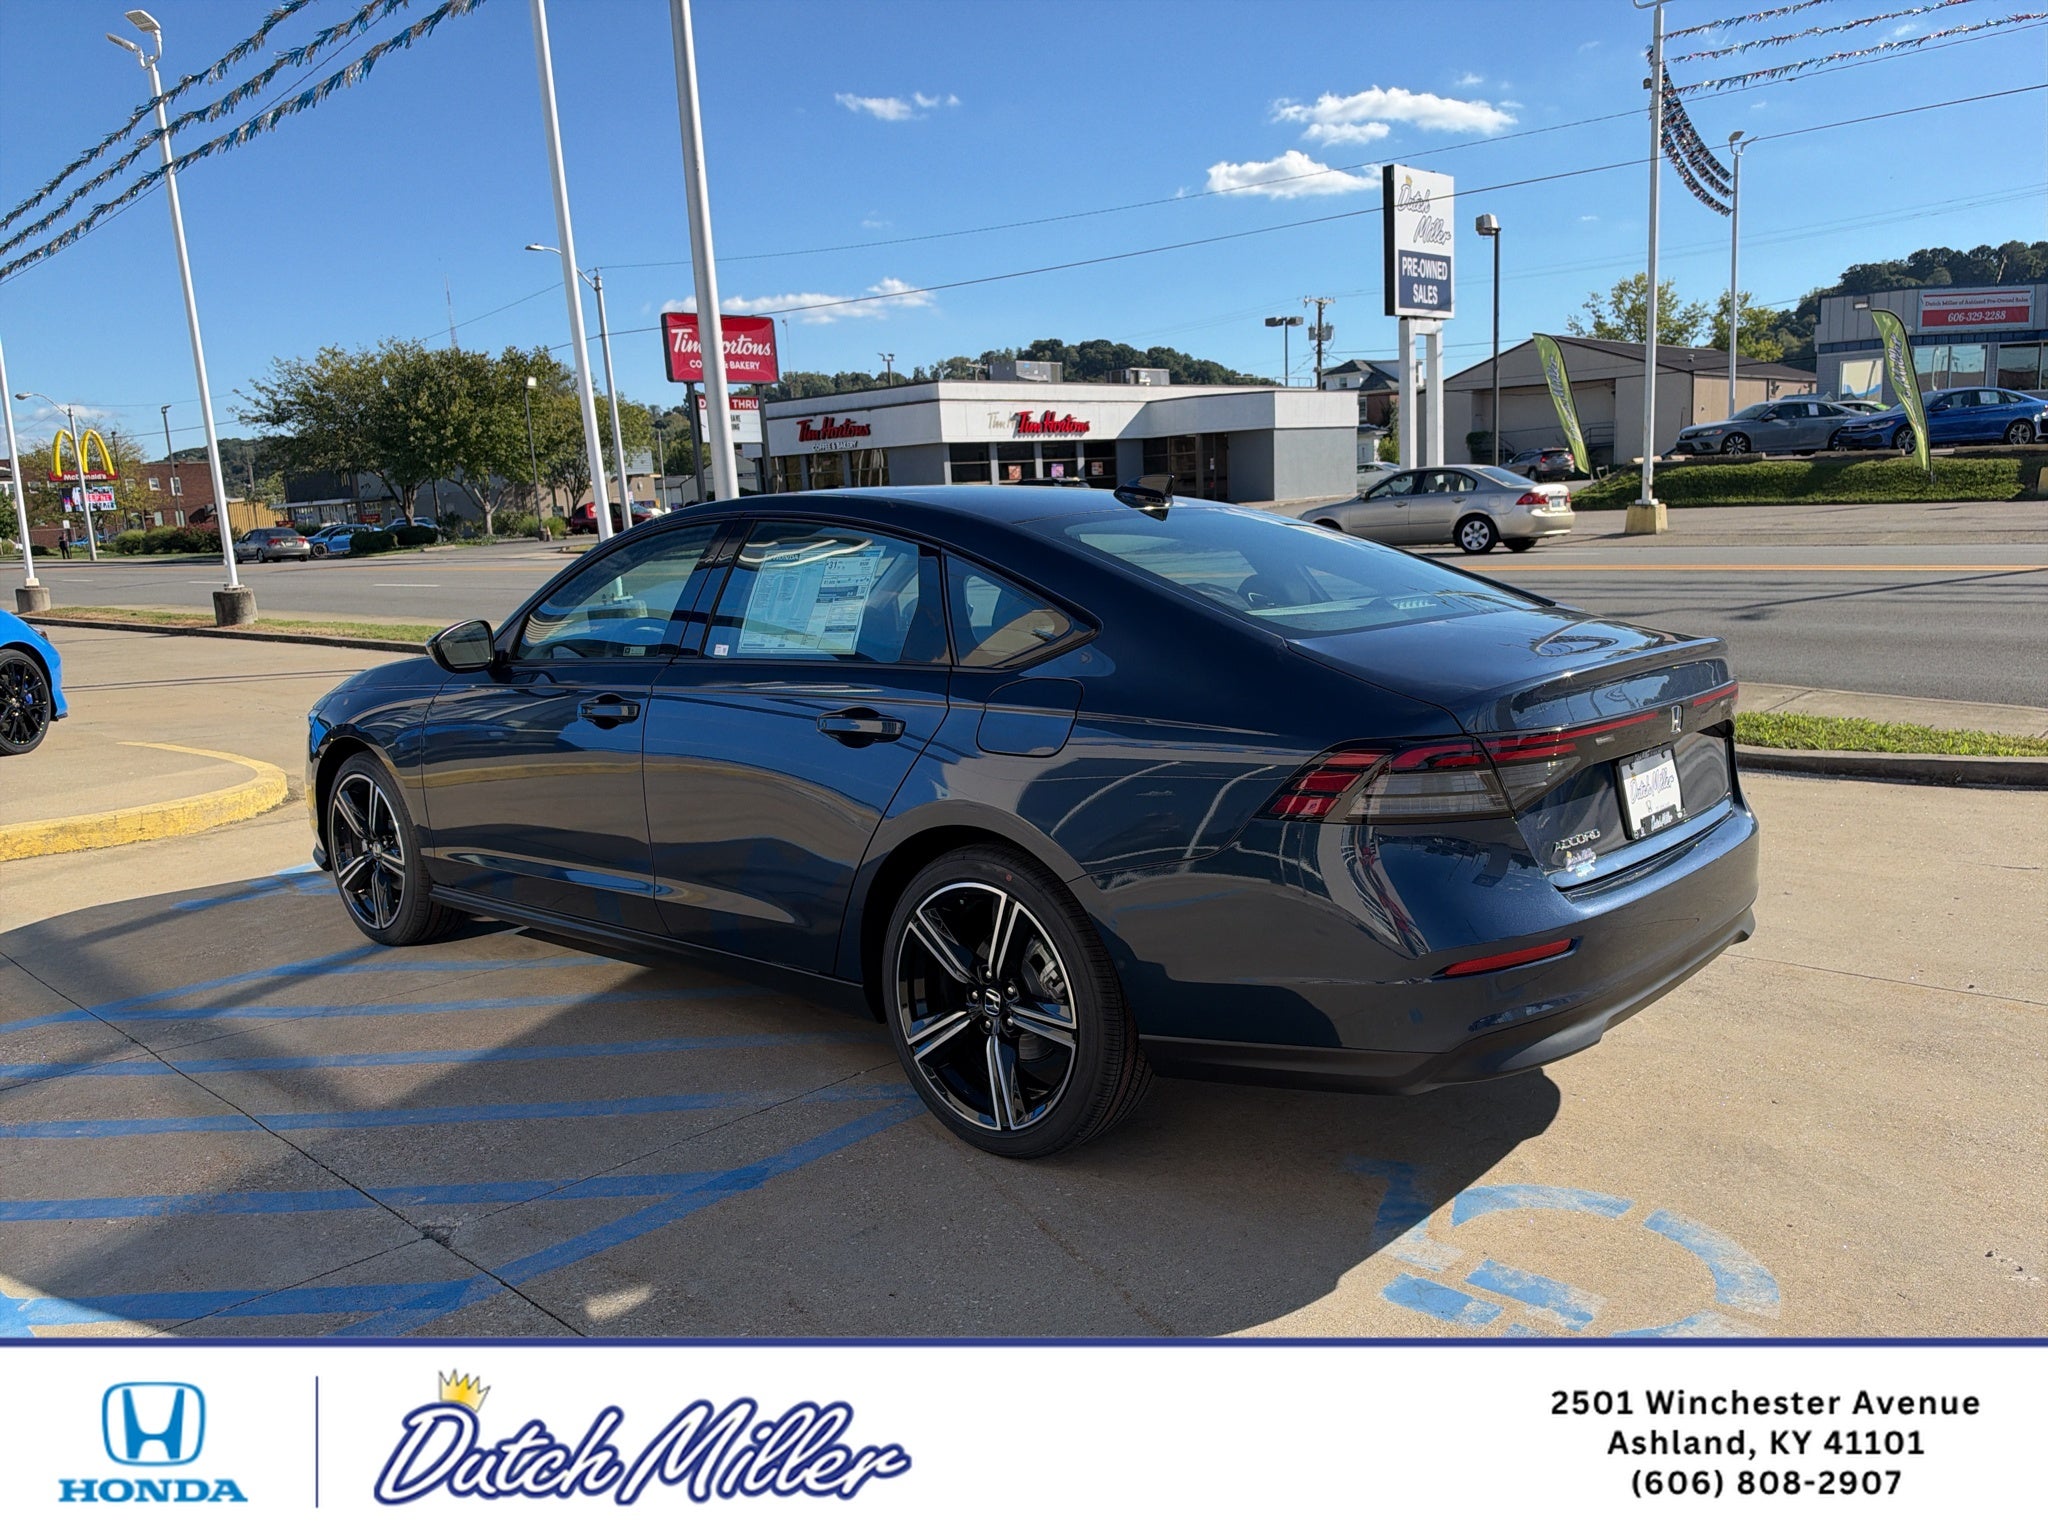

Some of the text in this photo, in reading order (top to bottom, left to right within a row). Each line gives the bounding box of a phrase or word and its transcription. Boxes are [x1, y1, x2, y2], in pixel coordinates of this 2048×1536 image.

[1398, 184, 1431, 214] Dutch
[1413, 215, 1452, 245] Miller
[1402, 256, 1448, 281] PRE-OWNED
[1413, 283, 1438, 305] SALES
[1942, 299, 1958, 307] Miller
[1947, 310, 2007, 322] 606-329-2288
[720, 331, 771, 356] ortons
[729, 360, 760, 370] BAKERY
[732, 399, 759, 409] THRU
[796, 416, 871, 442] Tim Hortons
[1017, 410, 1041, 434] Tim
[1040, 409, 1090, 434] Hortons
[1554, 829, 1601, 852] ACCORD
